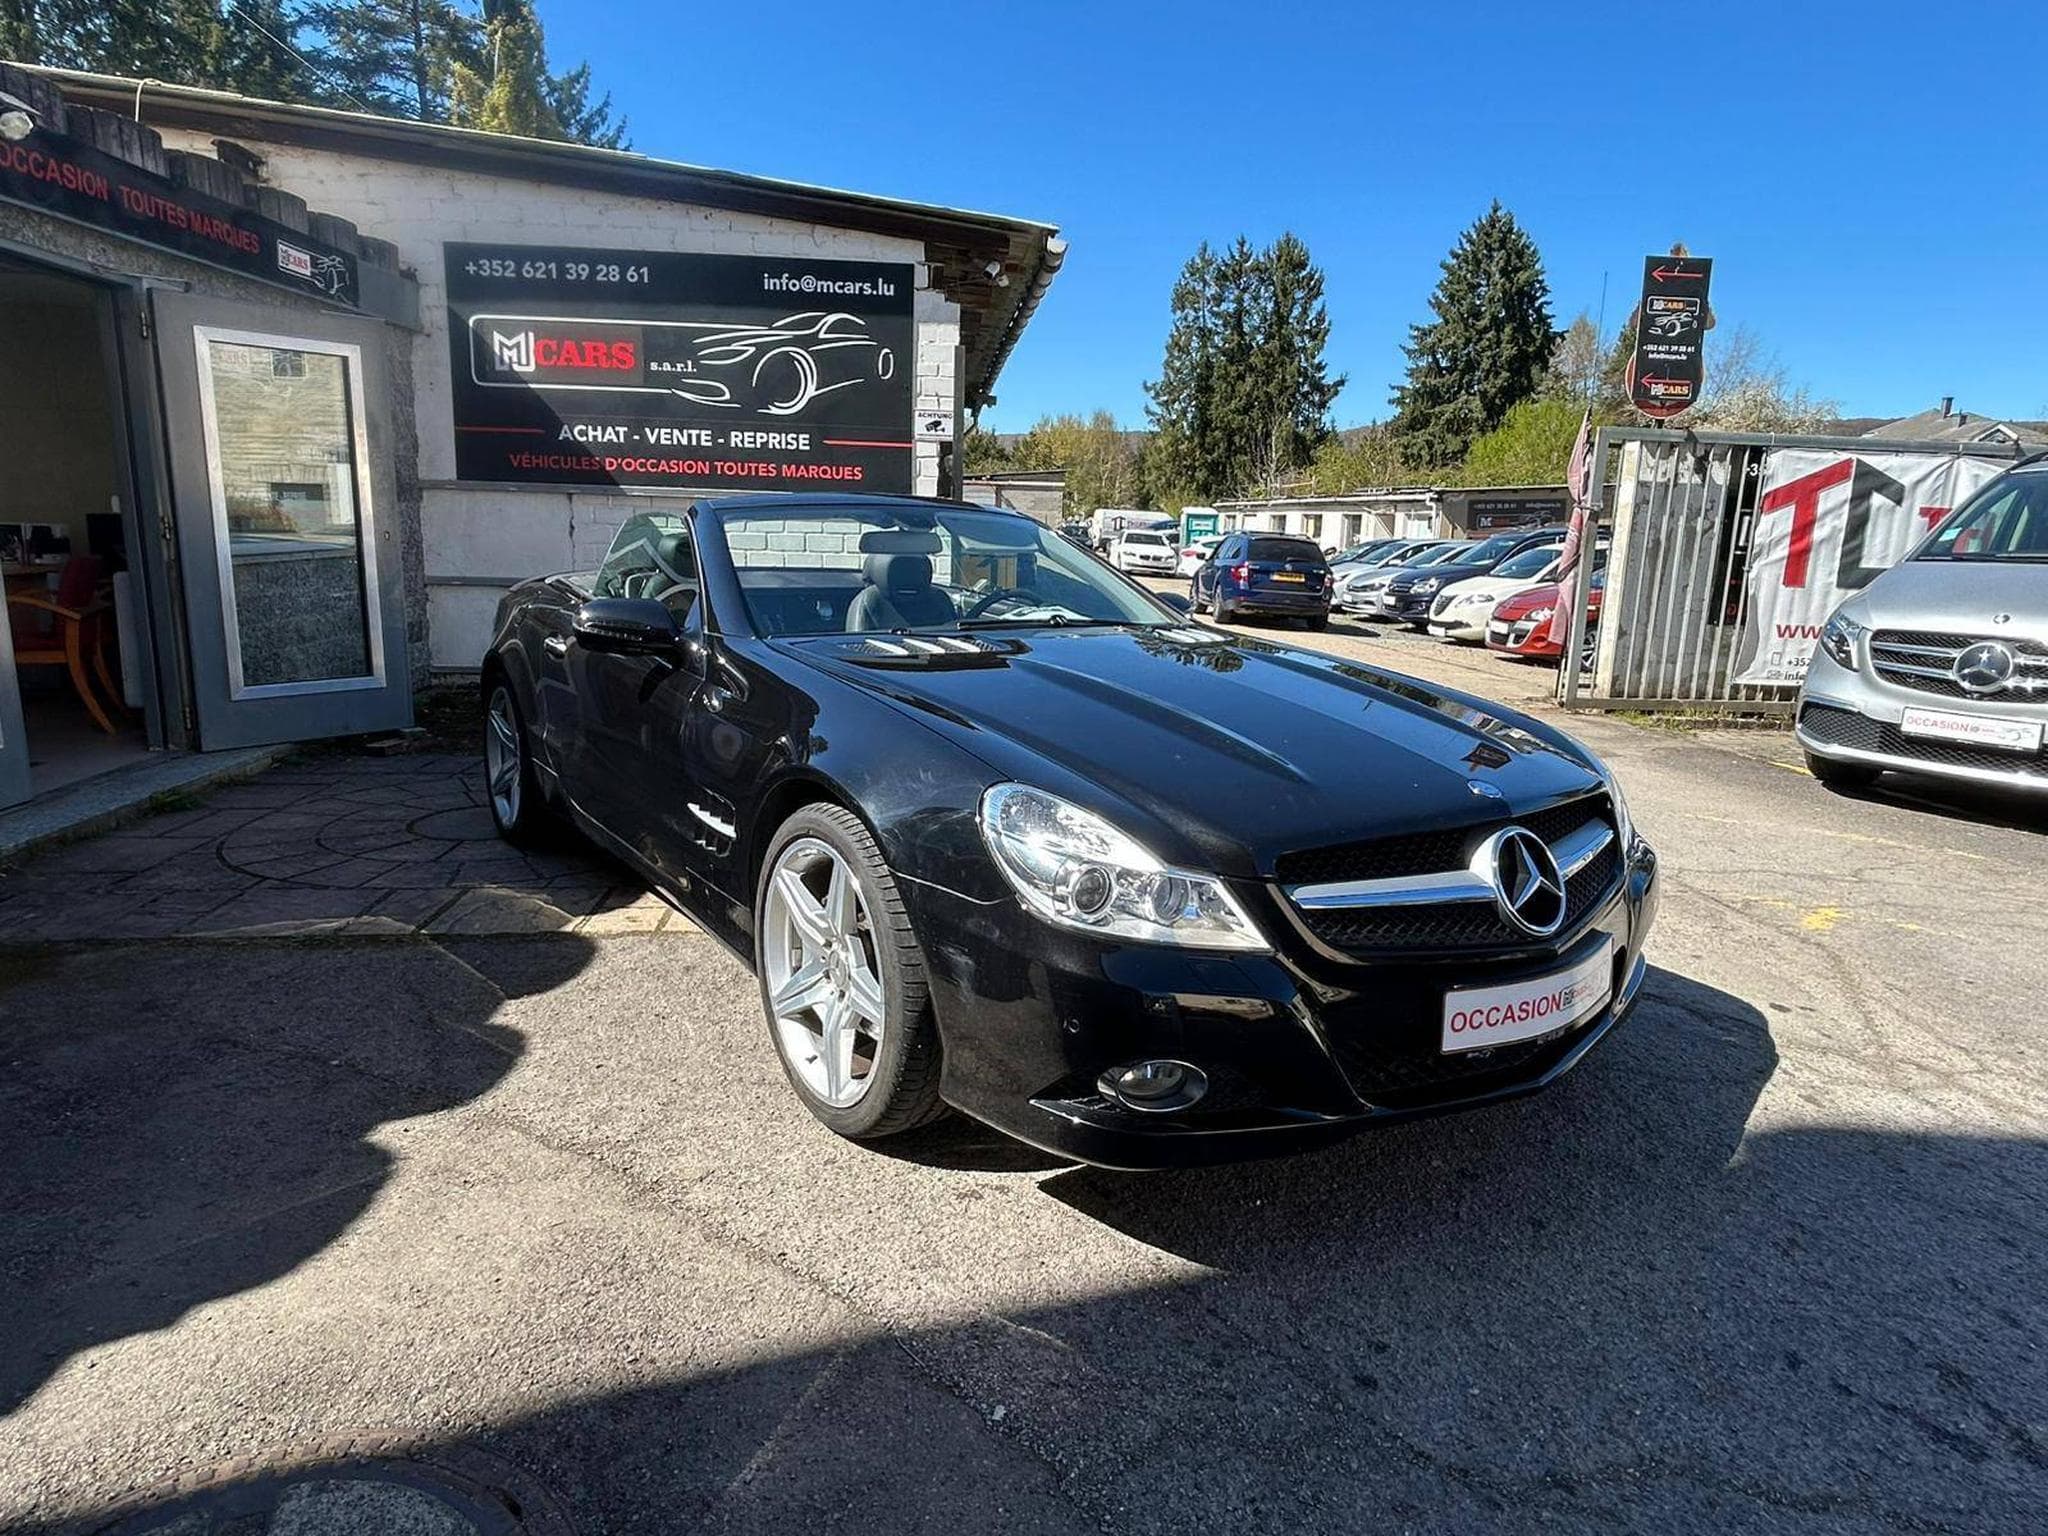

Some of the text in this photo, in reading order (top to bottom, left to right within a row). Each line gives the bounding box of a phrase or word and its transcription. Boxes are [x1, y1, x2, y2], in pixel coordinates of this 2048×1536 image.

[118, 185, 187, 229] TOUTES
[190, 211, 261, 255] MARQUES
[465, 259, 650, 283] +352 621 39 28 61
[763, 273, 895, 296] info@mcars.lu
[650, 360, 697, 372] s.a.r.l.
[558, 424, 628, 443] ACHAT
[645, 427, 713, 446] VENTE
[730, 431, 811, 450] REPRISE
[509, 452, 863, 480] VÉHICULES D'OCCASION TOUTES MARQUES
[1905, 715, 1970, 733] OCCASION
[1451, 991, 1562, 1033] OCCASION
